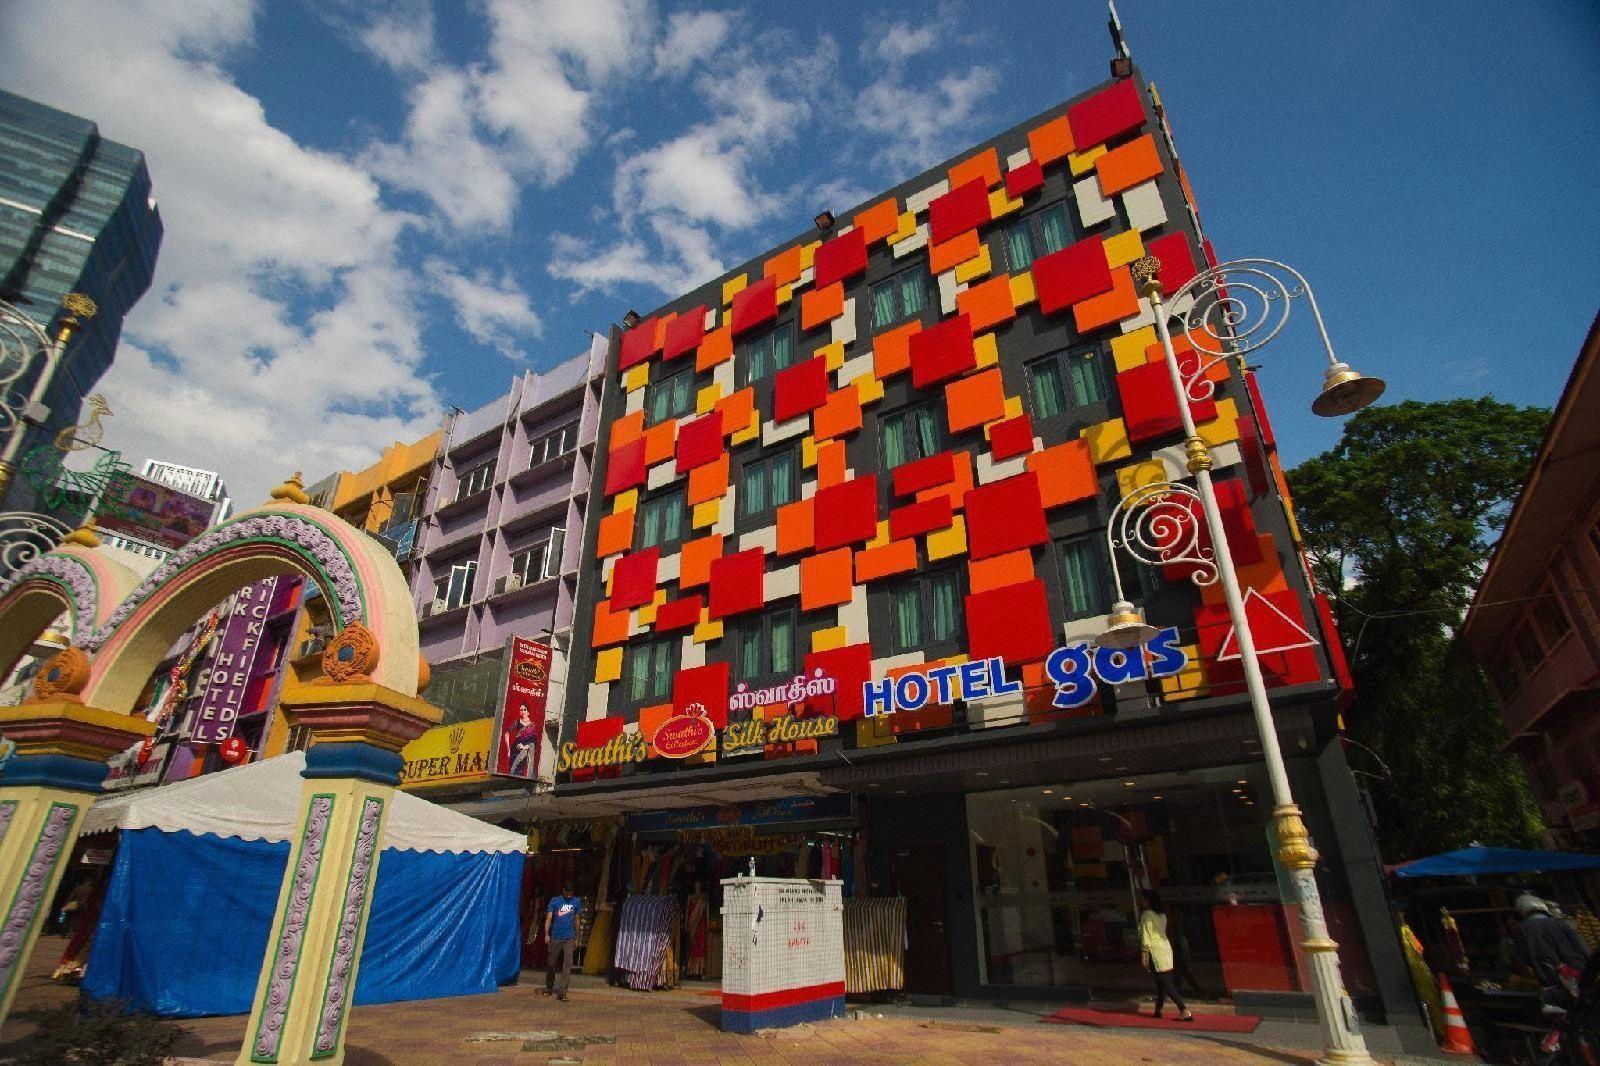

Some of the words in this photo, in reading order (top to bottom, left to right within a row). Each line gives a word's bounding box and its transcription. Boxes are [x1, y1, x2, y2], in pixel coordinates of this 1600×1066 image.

[215, 576, 275, 741] RICKFIELDS
[863, 656, 1022, 717] HOTEL
[1045, 626, 1189, 708] gas
[196, 652, 234, 740] HOTEL
[729, 668, 835, 711] ஸ்வாதிஸ்
[558, 731, 648, 773] Swathi's
[723, 720, 764, 750] Silk
[769, 714, 836, 743] House
[662, 723, 703, 741] Swathi's
[453, 751, 491, 774] MA
